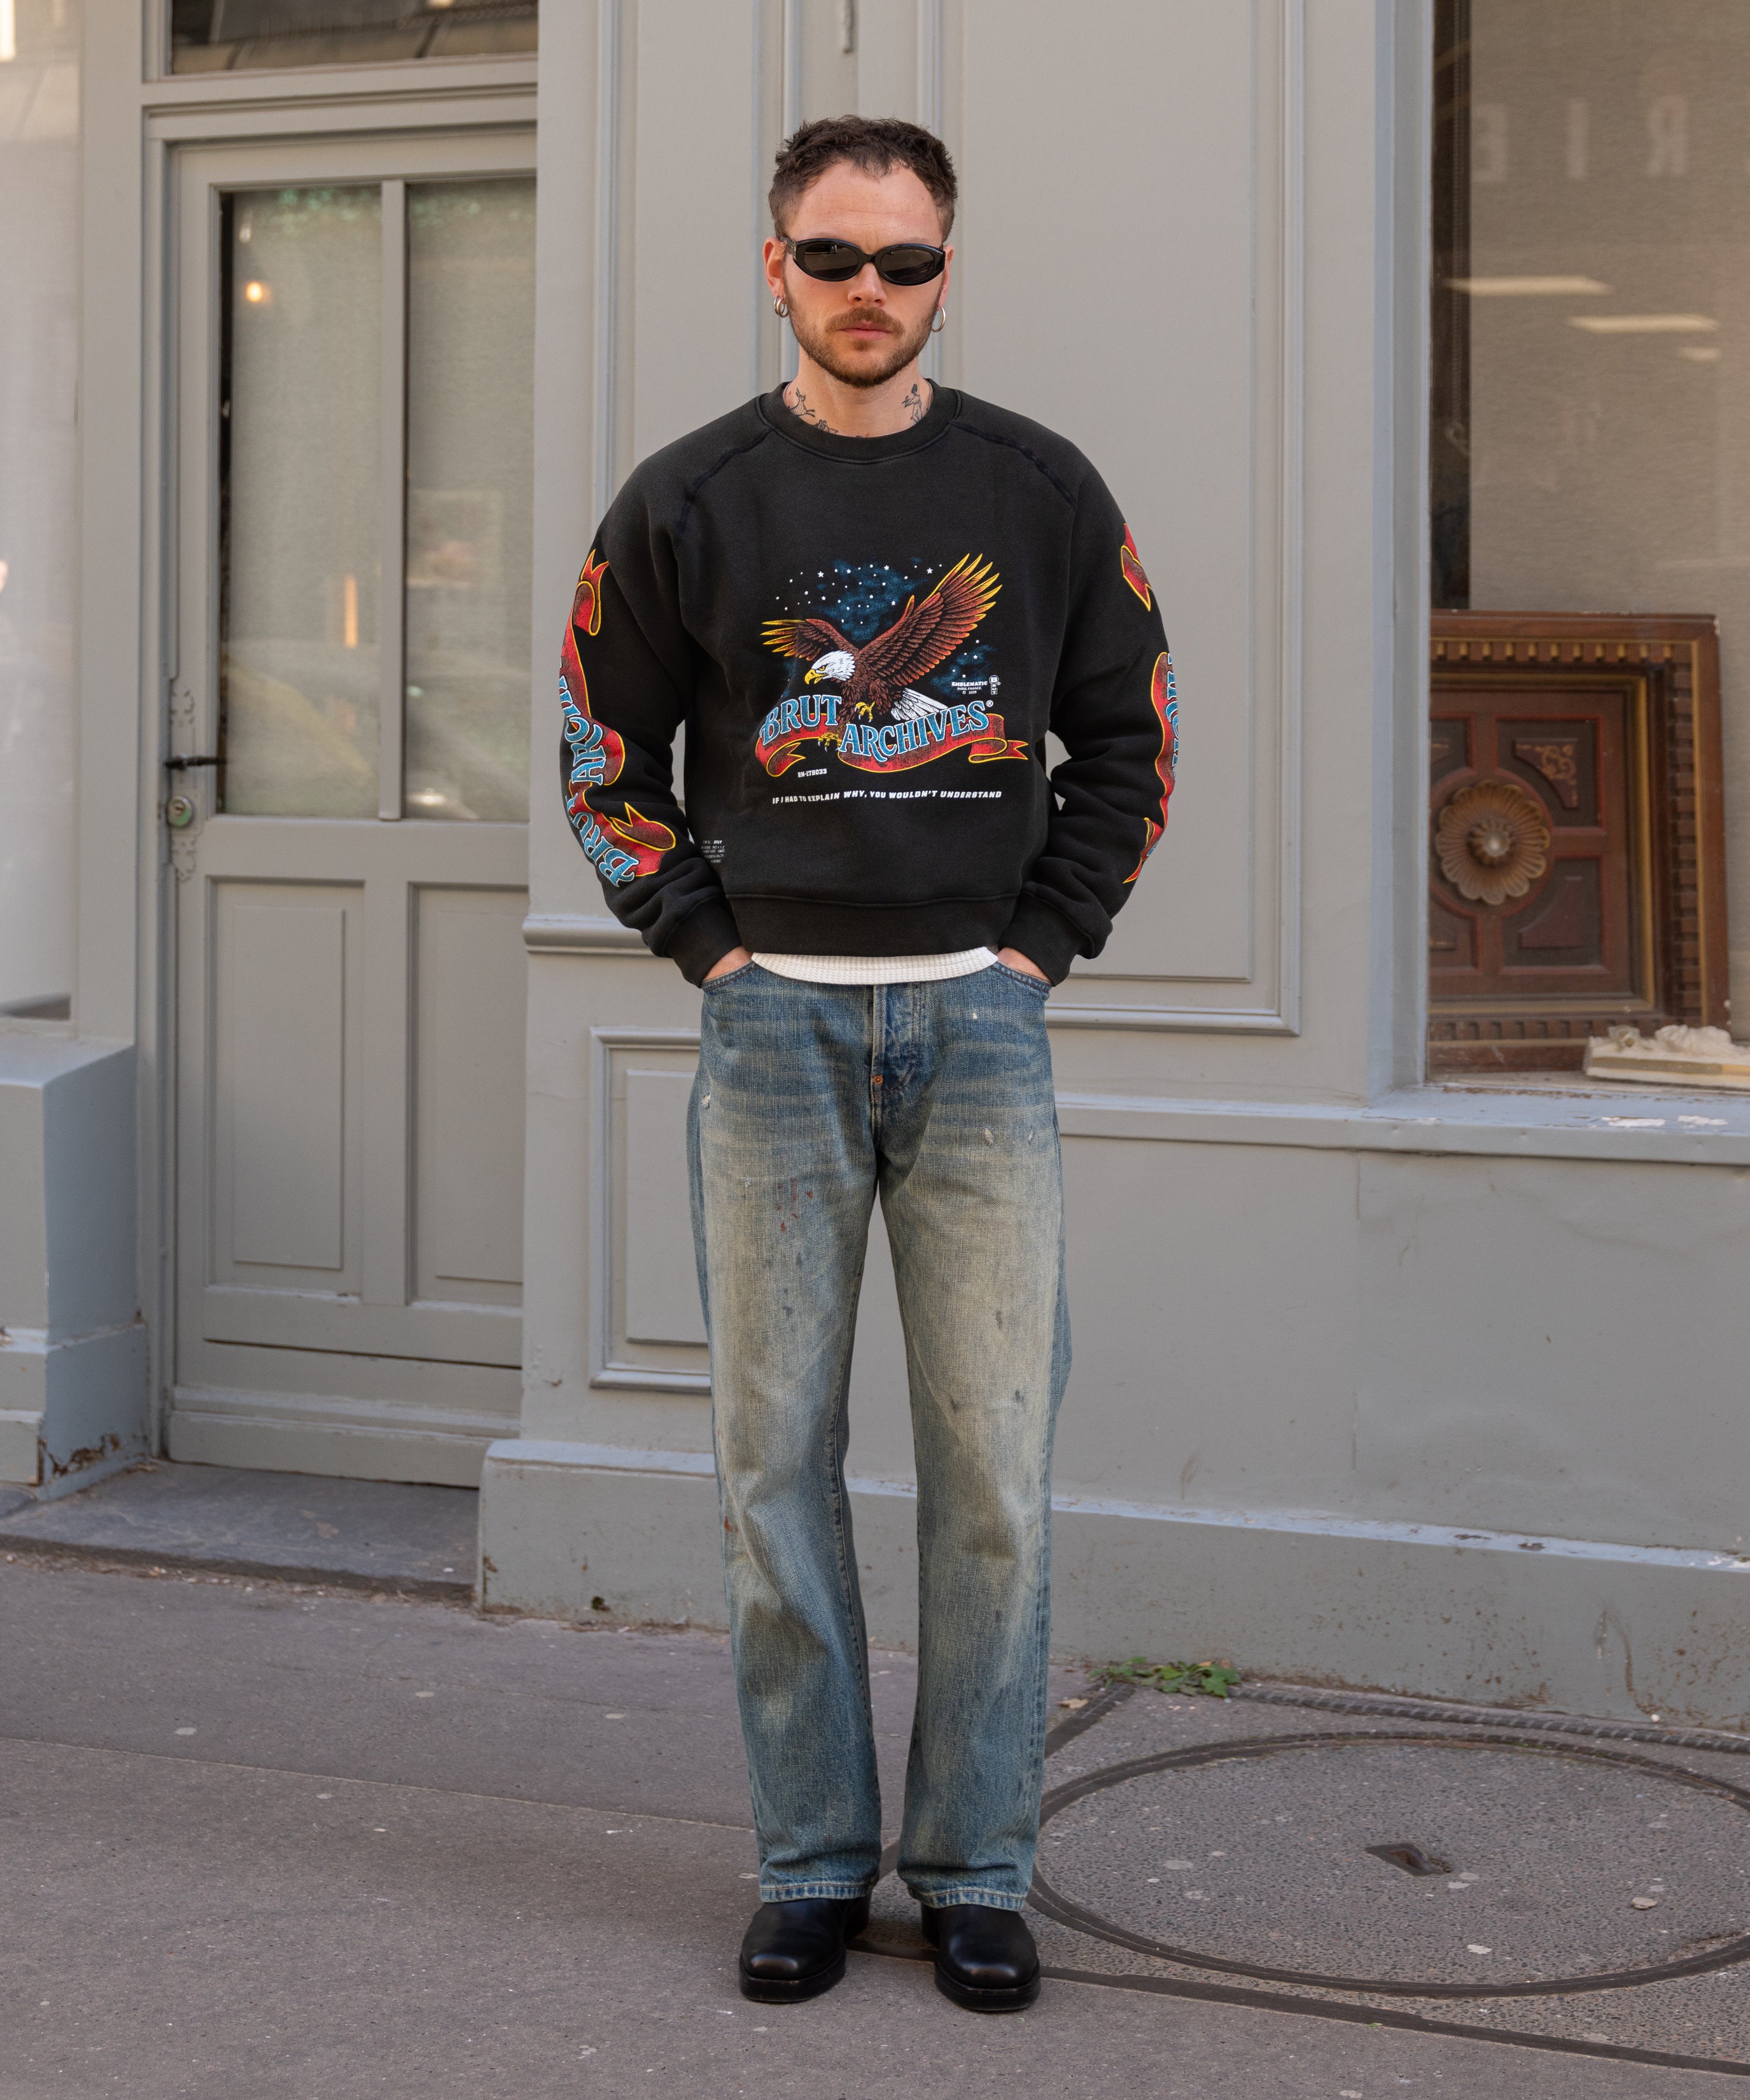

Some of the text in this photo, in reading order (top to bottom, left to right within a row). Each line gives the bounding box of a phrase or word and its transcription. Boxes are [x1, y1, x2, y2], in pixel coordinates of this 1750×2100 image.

[759, 694, 841, 746] BRUT
[807, 792, 840, 802] EXPLAIN
[843, 790, 867, 799] WHY,
[869, 790, 886, 799] YOU
[940, 790, 1002, 799] UNDERSTAND
